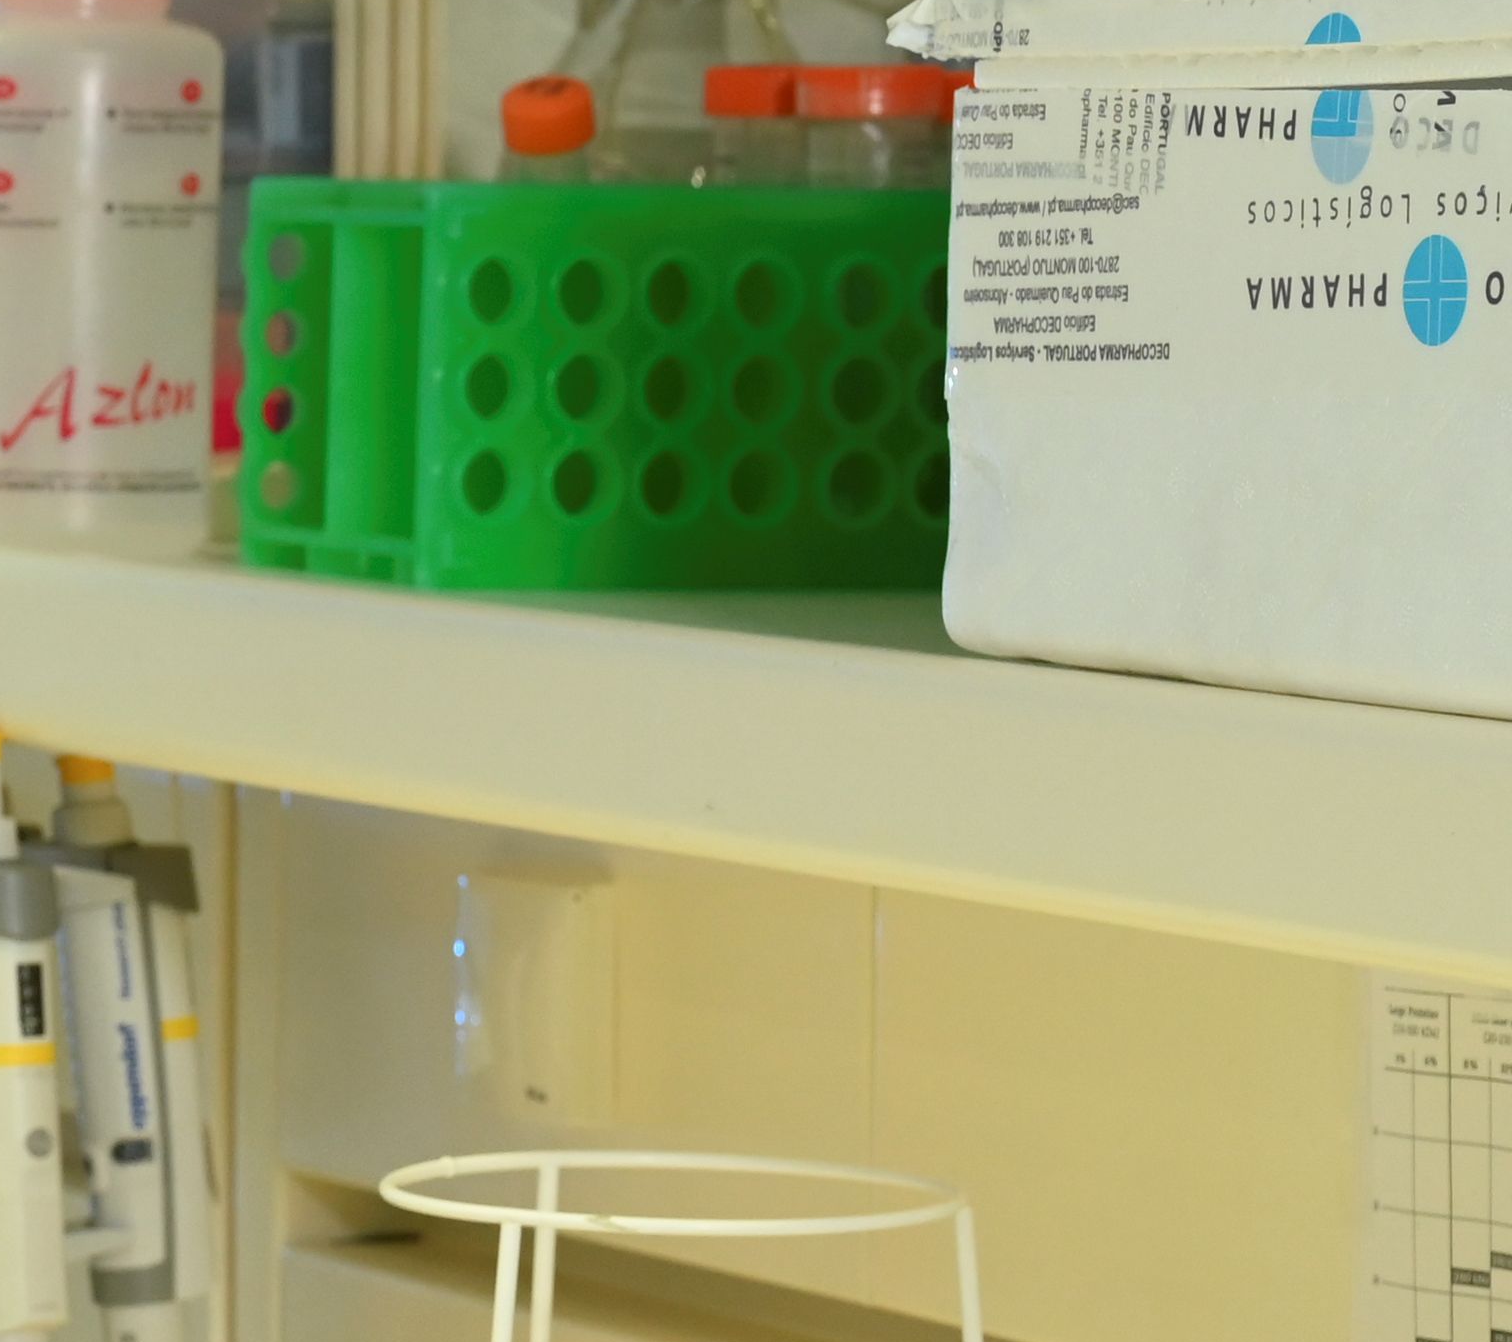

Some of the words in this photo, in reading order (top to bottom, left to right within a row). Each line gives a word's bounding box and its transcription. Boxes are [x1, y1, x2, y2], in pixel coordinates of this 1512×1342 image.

[1247, 185, 1411, 228] Logísticos
[998, 230, 1014, 248] 300
[1035, 229, 1051, 247] 219
[1033, 258, 1076, 276] MONTIJO
[1079, 255, 1120, 274] 2870-100
[1015, 286, 1060, 304] Queimado
[1062, 286, 1079, 303] Pau
[1082, 286, 1093, 303] do
[1095, 284, 1128, 303] Estrada
[1247, 272, 1389, 311] PHARMA
[994, 315, 1062, 334] DECOPHARMA
[1044, 344, 1097, 361] PORTUGAL
[1099, 342, 1170, 361] DECOPHARMA
